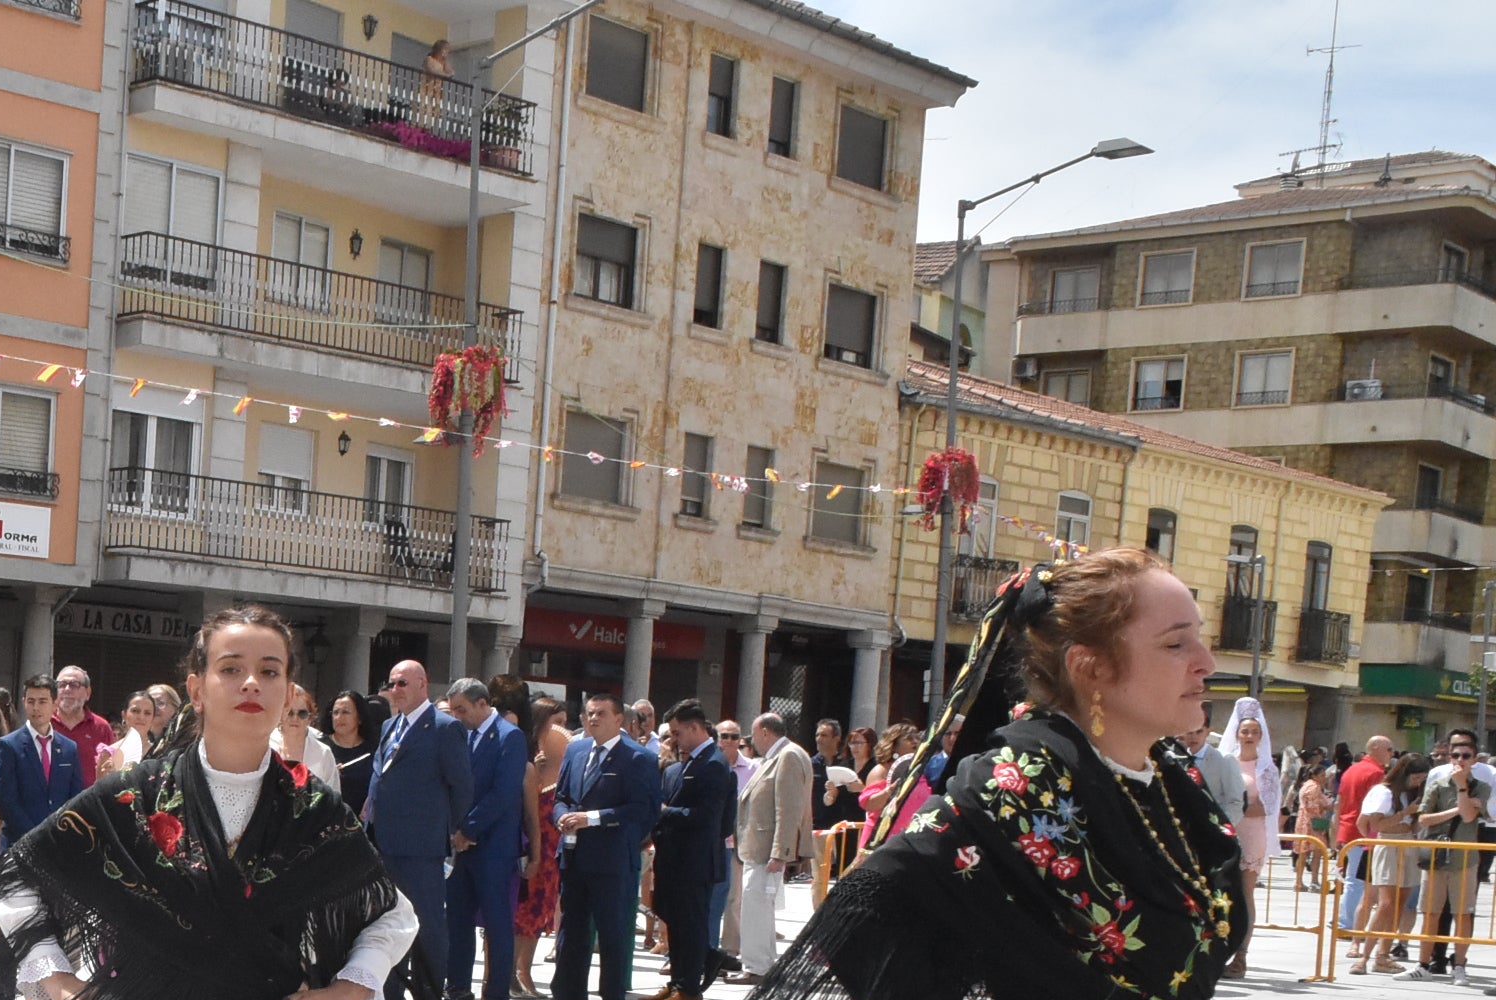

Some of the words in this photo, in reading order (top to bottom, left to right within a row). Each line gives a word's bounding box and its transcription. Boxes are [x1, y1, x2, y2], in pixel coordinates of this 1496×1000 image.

[17, 545, 40, 553] FISCAL
[82, 609, 103, 630] LA
[111, 612, 152, 635] CASA
[593, 625, 628, 645] Halc
